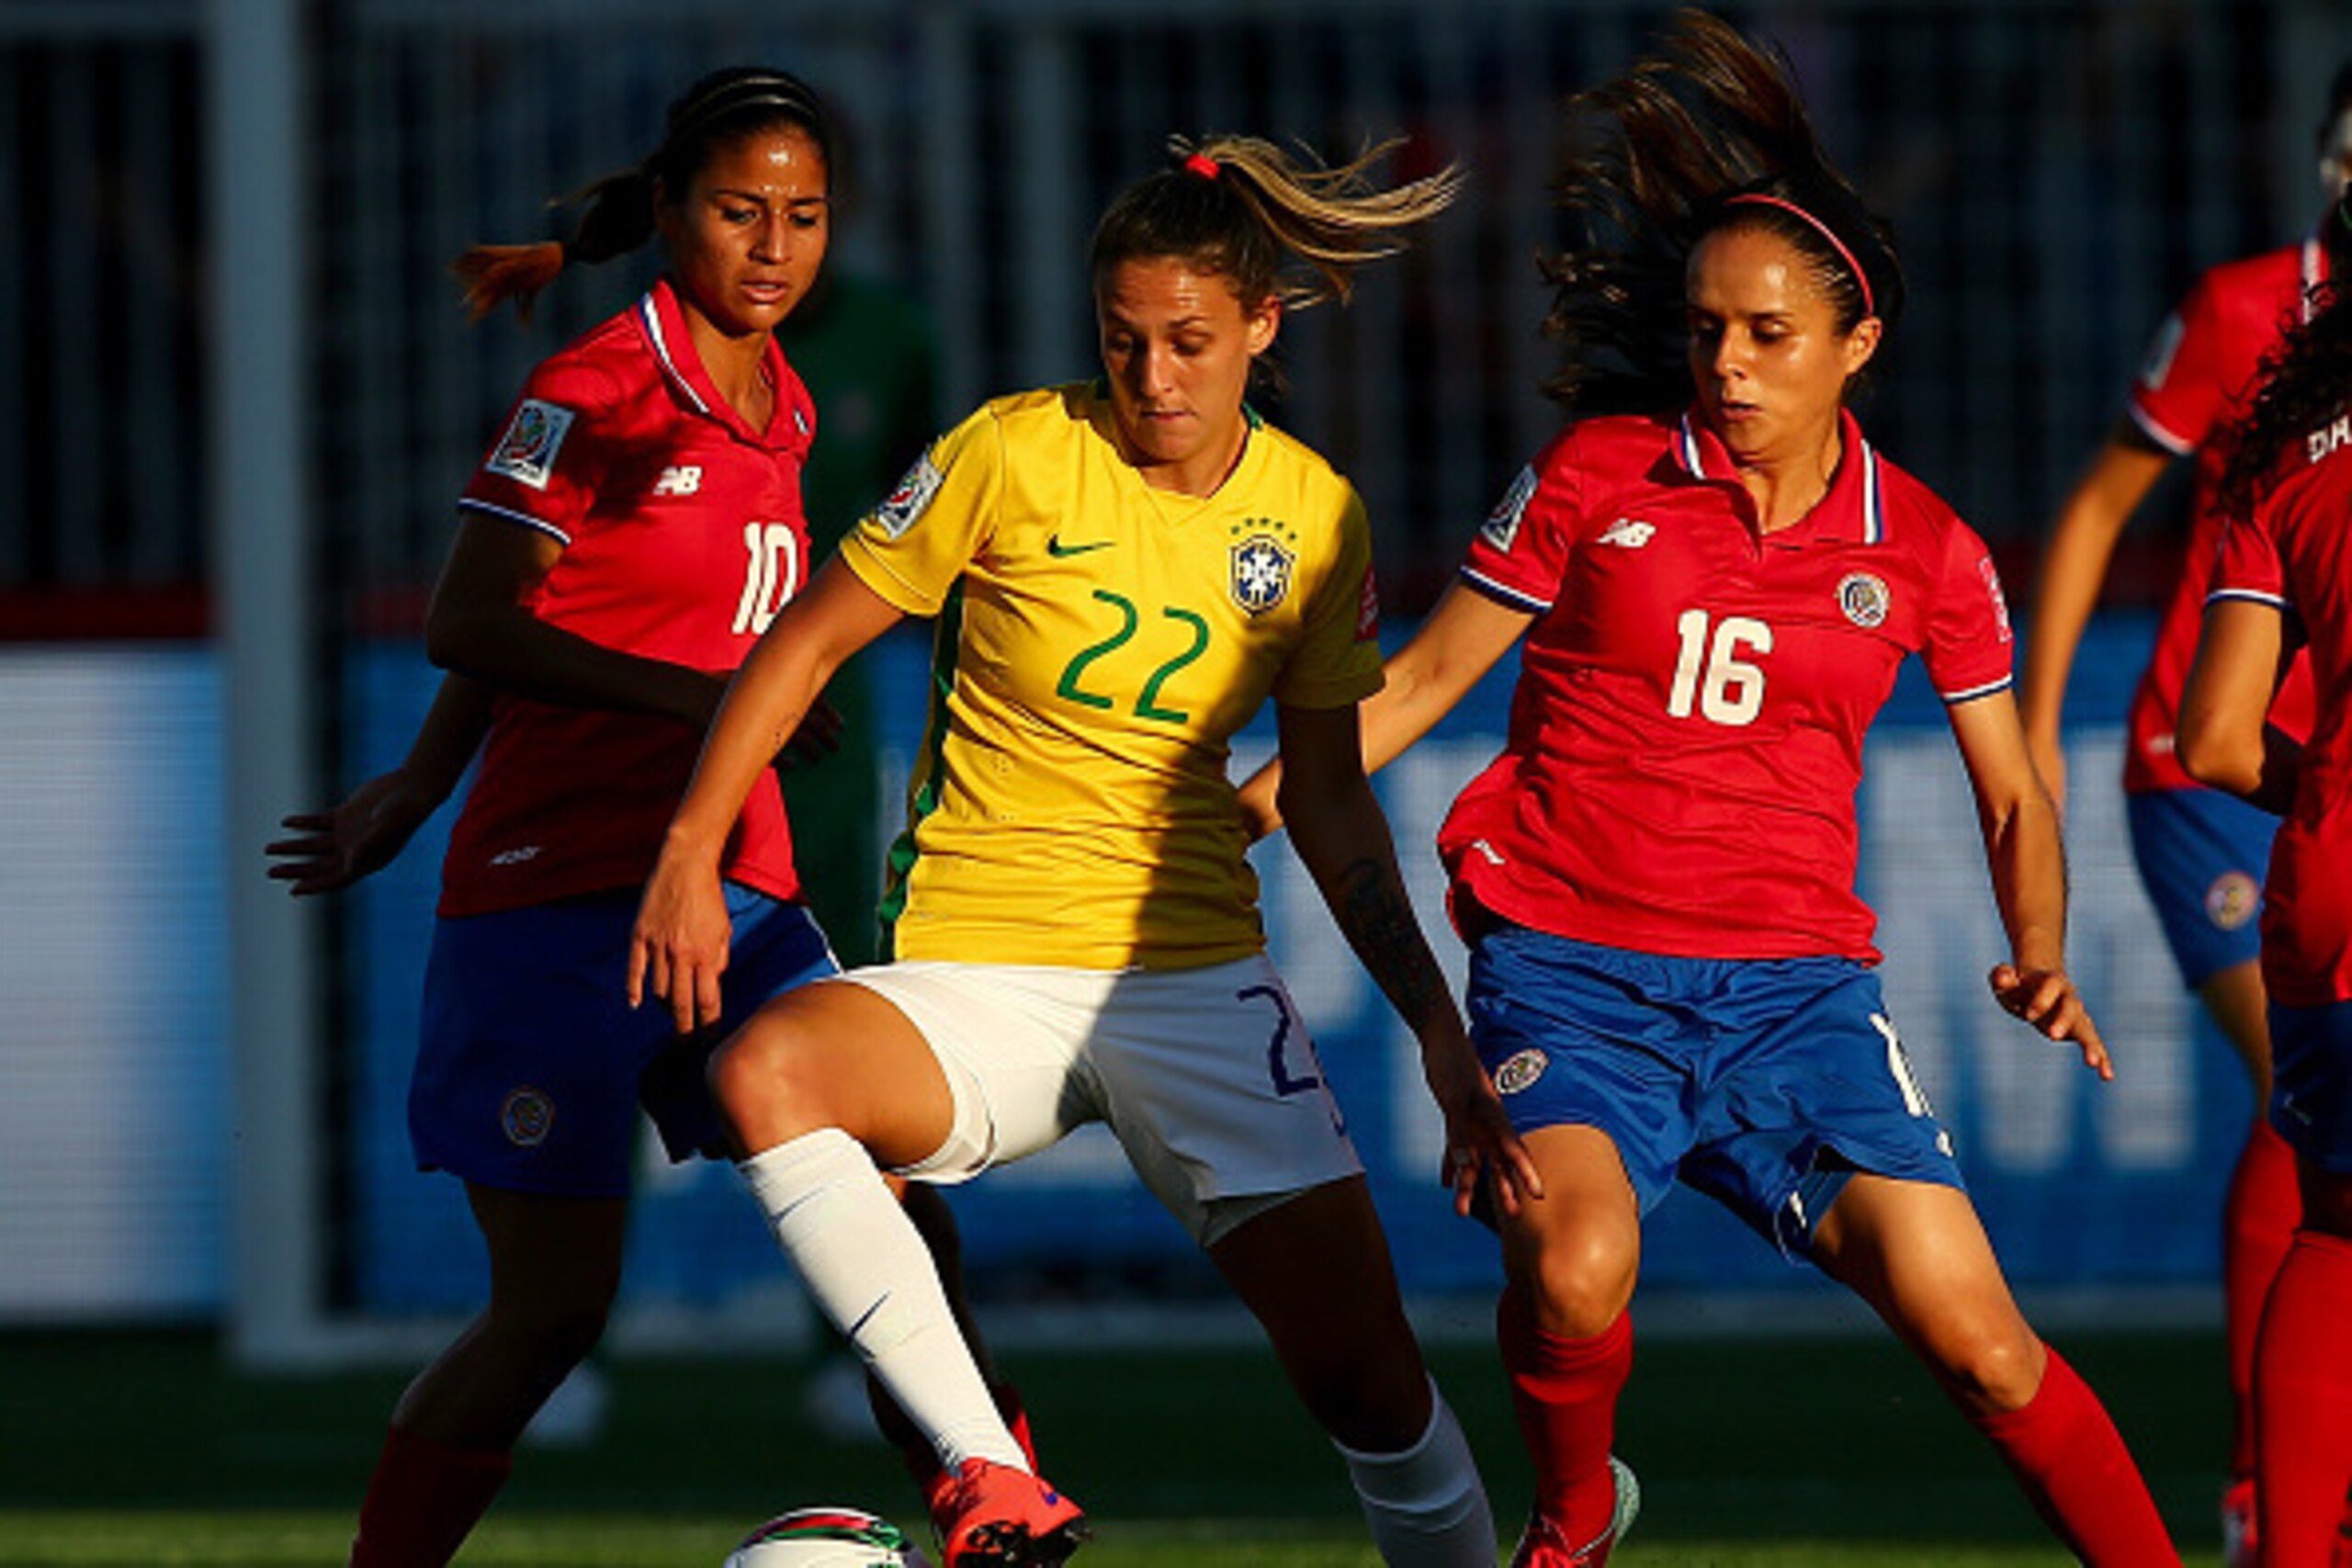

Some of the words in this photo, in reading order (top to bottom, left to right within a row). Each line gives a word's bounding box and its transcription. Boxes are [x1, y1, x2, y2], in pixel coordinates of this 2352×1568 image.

[731, 521, 797, 636] 10
[1055, 590, 1210, 723] 22
[1668, 609, 1774, 727] 16
[1236, 985, 1328, 1111] 2
